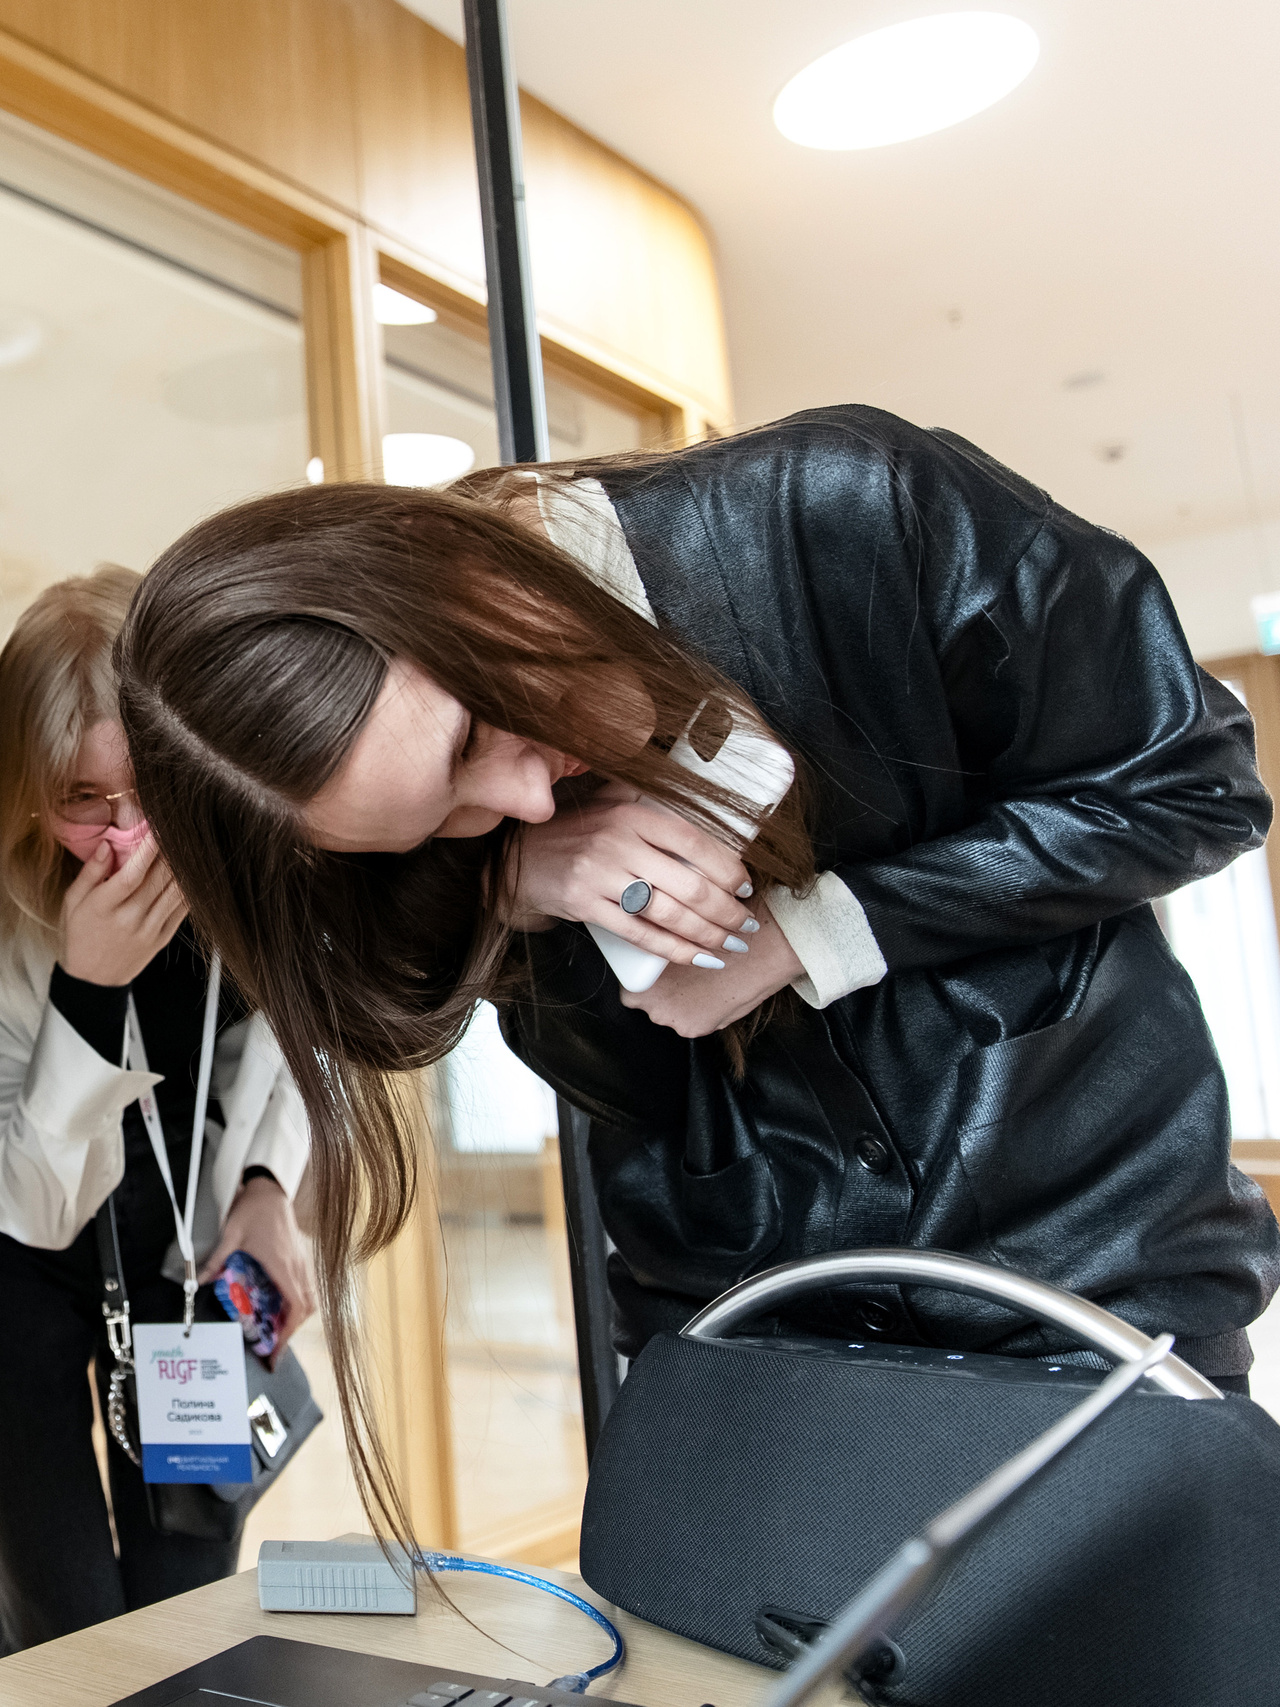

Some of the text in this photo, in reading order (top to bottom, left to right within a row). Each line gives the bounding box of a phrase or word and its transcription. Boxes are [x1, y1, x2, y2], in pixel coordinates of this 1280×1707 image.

[158, 1360, 197, 1385] RIGF
[171, 1399, 215, 1409] Полина
[167, 1412, 222, 1423] Садикова
